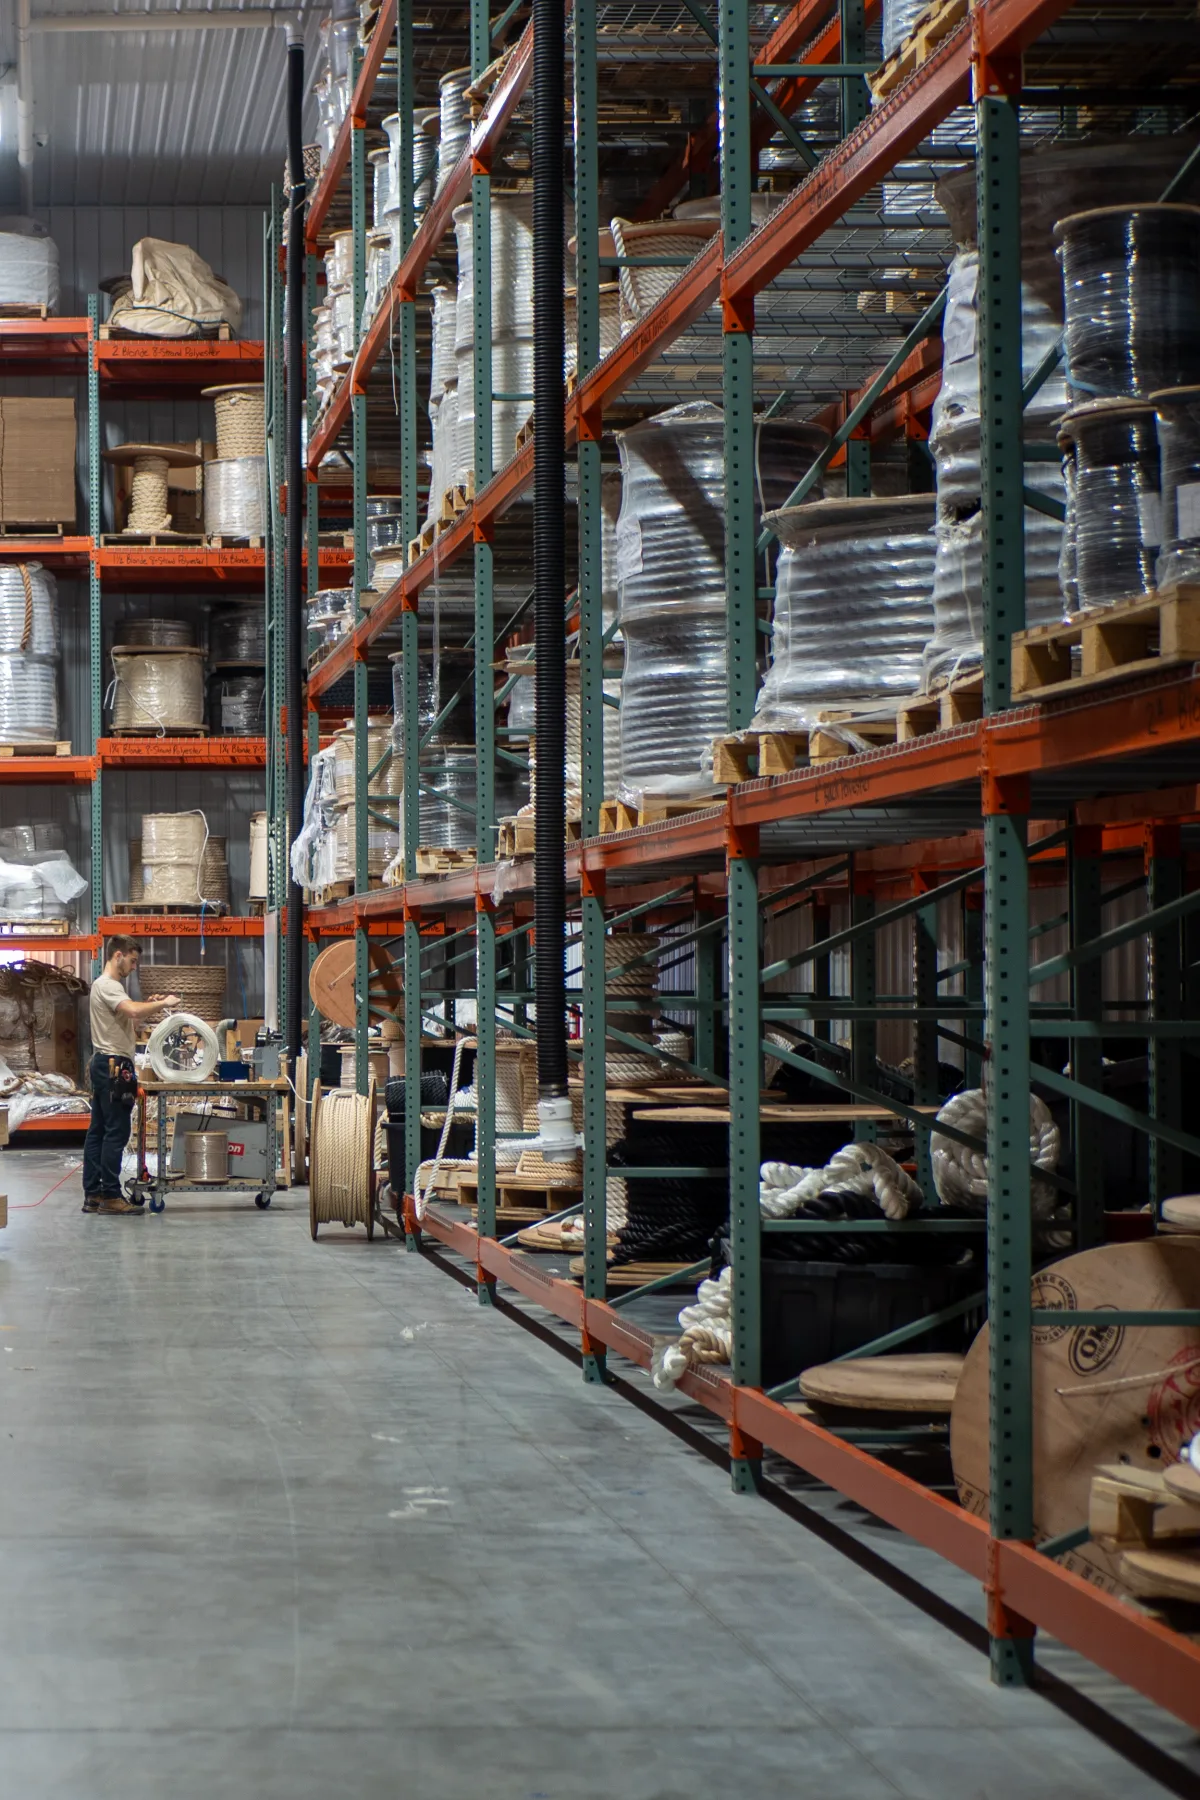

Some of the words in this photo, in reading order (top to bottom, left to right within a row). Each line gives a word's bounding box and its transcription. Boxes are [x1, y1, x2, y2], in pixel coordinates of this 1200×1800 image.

[112, 346, 119, 357] 2
[122, 346, 148, 357] Blonde
[185, 346, 220, 359] Polyester
[131, 923, 138, 933] 1
[144, 923, 168, 933] Blonde
